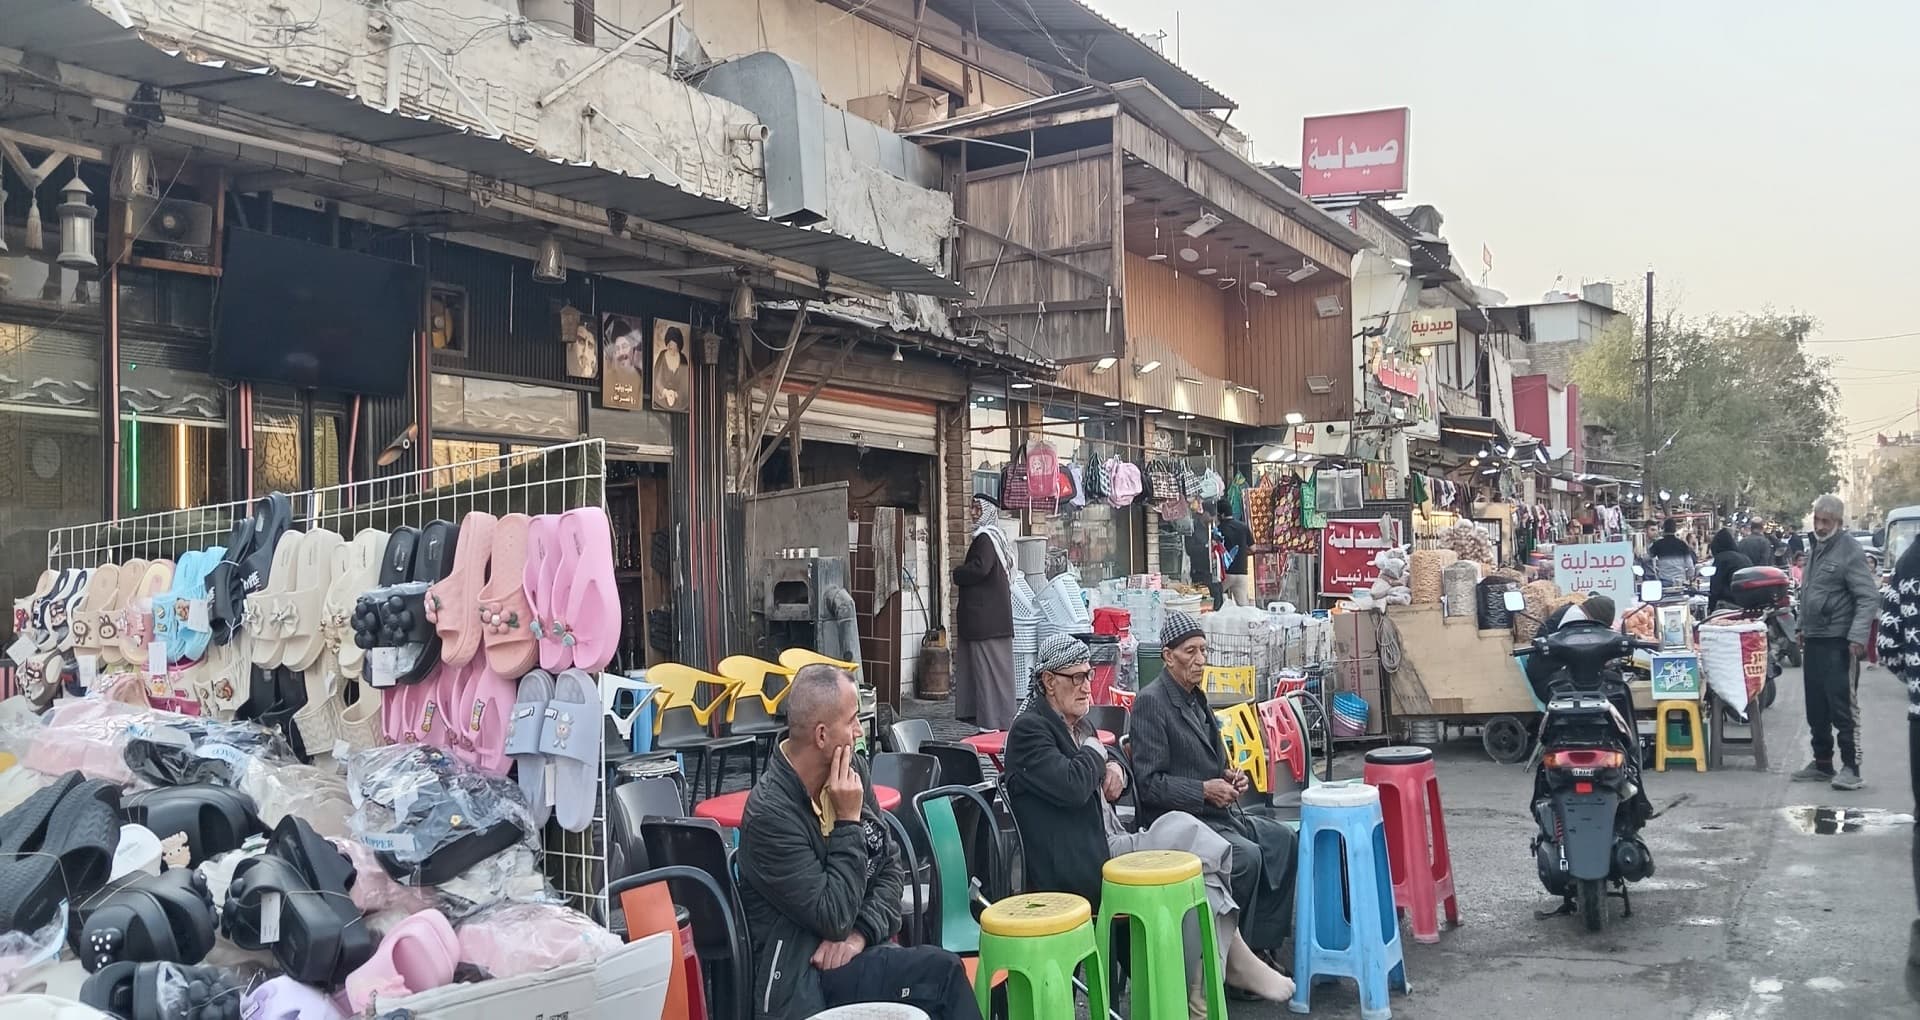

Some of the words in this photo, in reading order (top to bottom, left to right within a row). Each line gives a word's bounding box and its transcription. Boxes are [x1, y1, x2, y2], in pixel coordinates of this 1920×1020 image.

[1307, 135, 1399, 178] صيدلية
[1560, 550, 1626, 574] صيدلية
[1330, 568, 1362, 586] نبيل
[1570, 576, 1594, 592] نبيل
[1596, 576, 1617, 591] رغد
